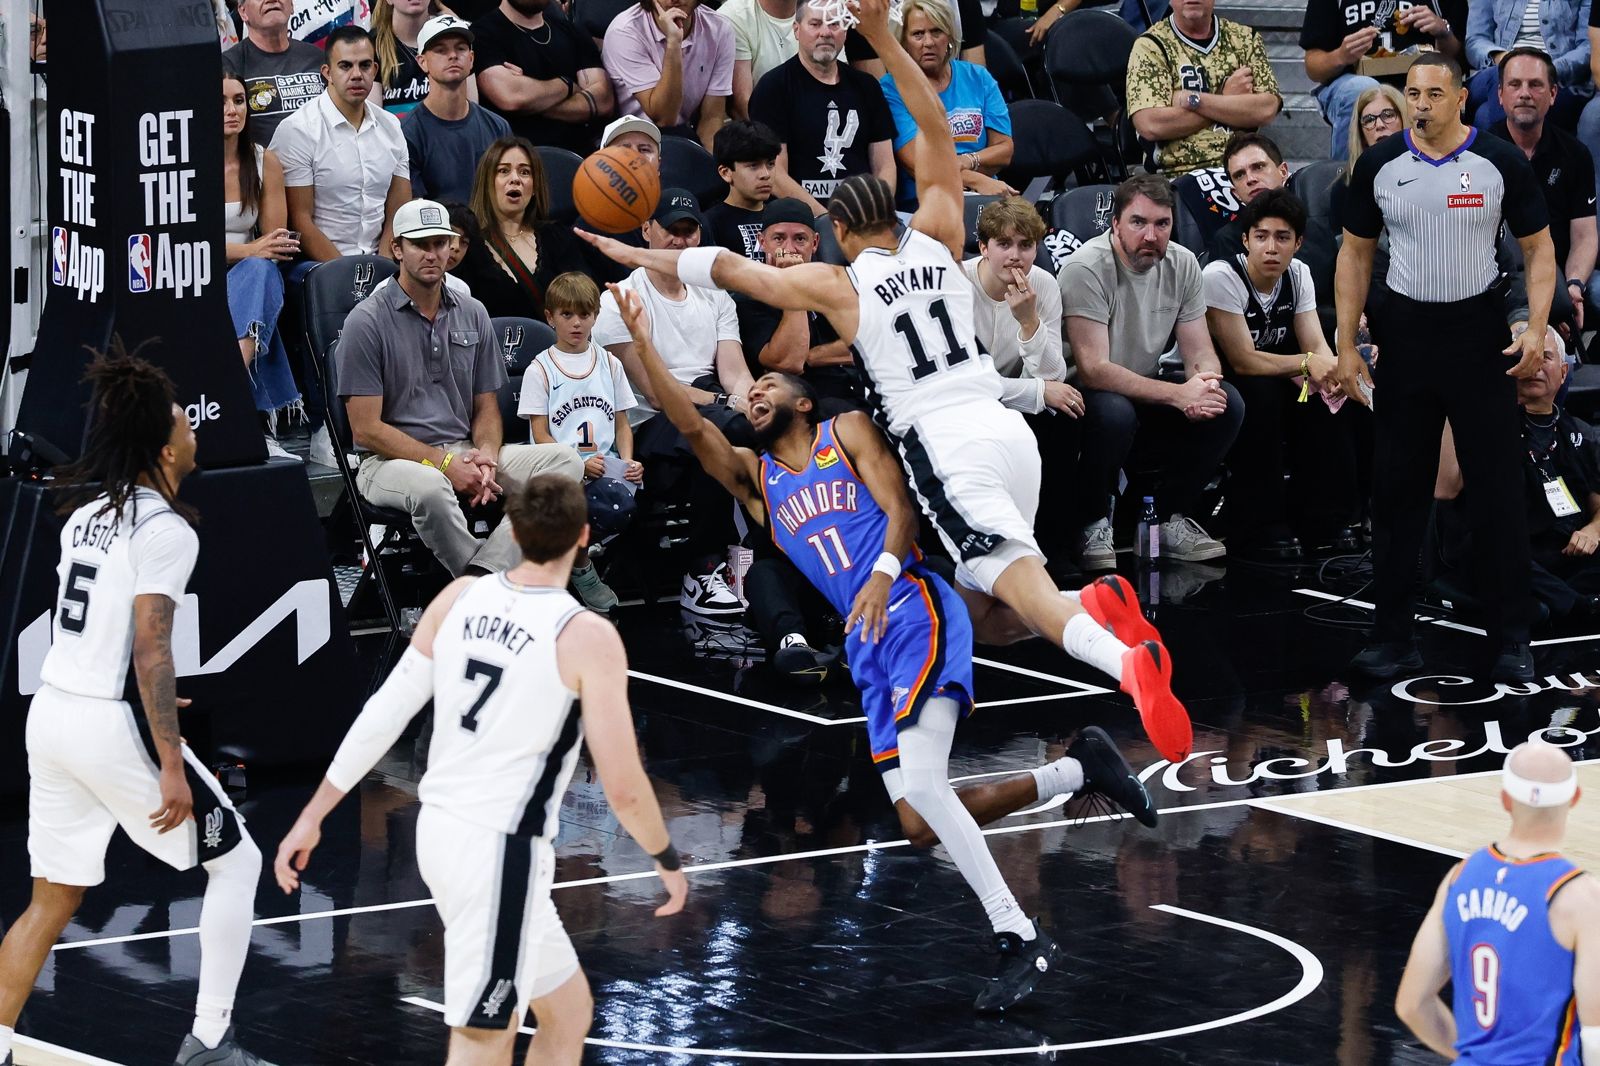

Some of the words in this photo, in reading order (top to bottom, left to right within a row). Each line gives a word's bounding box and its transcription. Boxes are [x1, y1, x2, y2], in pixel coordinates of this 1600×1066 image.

[278, 75, 319, 86] SPURS
[280, 86, 306, 97] MARINE
[384, 87, 401, 99] an
[403, 77, 430, 100] Ant
[1180, 64, 1210, 92] 21
[60, 108, 95, 167] GET
[138, 109, 194, 167] GET
[60, 168, 96, 227] THE
[139, 169, 197, 227] THE
[596, 159, 638, 206] Wilson
[804, 183, 829, 195] SAN
[1448, 197, 1483, 206] Emirates
[66, 231, 105, 303] App
[155, 232, 211, 298] App
[873, 266, 946, 307] BRYANT
[892, 297, 971, 382] 11
[551, 402, 573, 427] SAN
[573, 396, 615, 422] ANTONIO
[577, 420, 597, 452] 1
[776, 480, 858, 537] THUNDER
[72, 521, 119, 555] CASTLE
[806, 524, 853, 577] 11
[59, 559, 100, 637] 5
[463, 615, 535, 656] KORNET
[459, 656, 506, 734] 7
[1391, 664, 1600, 706] Cou
[1456, 887, 1529, 932] CARUSO
[1470, 943, 1501, 1030] 9
